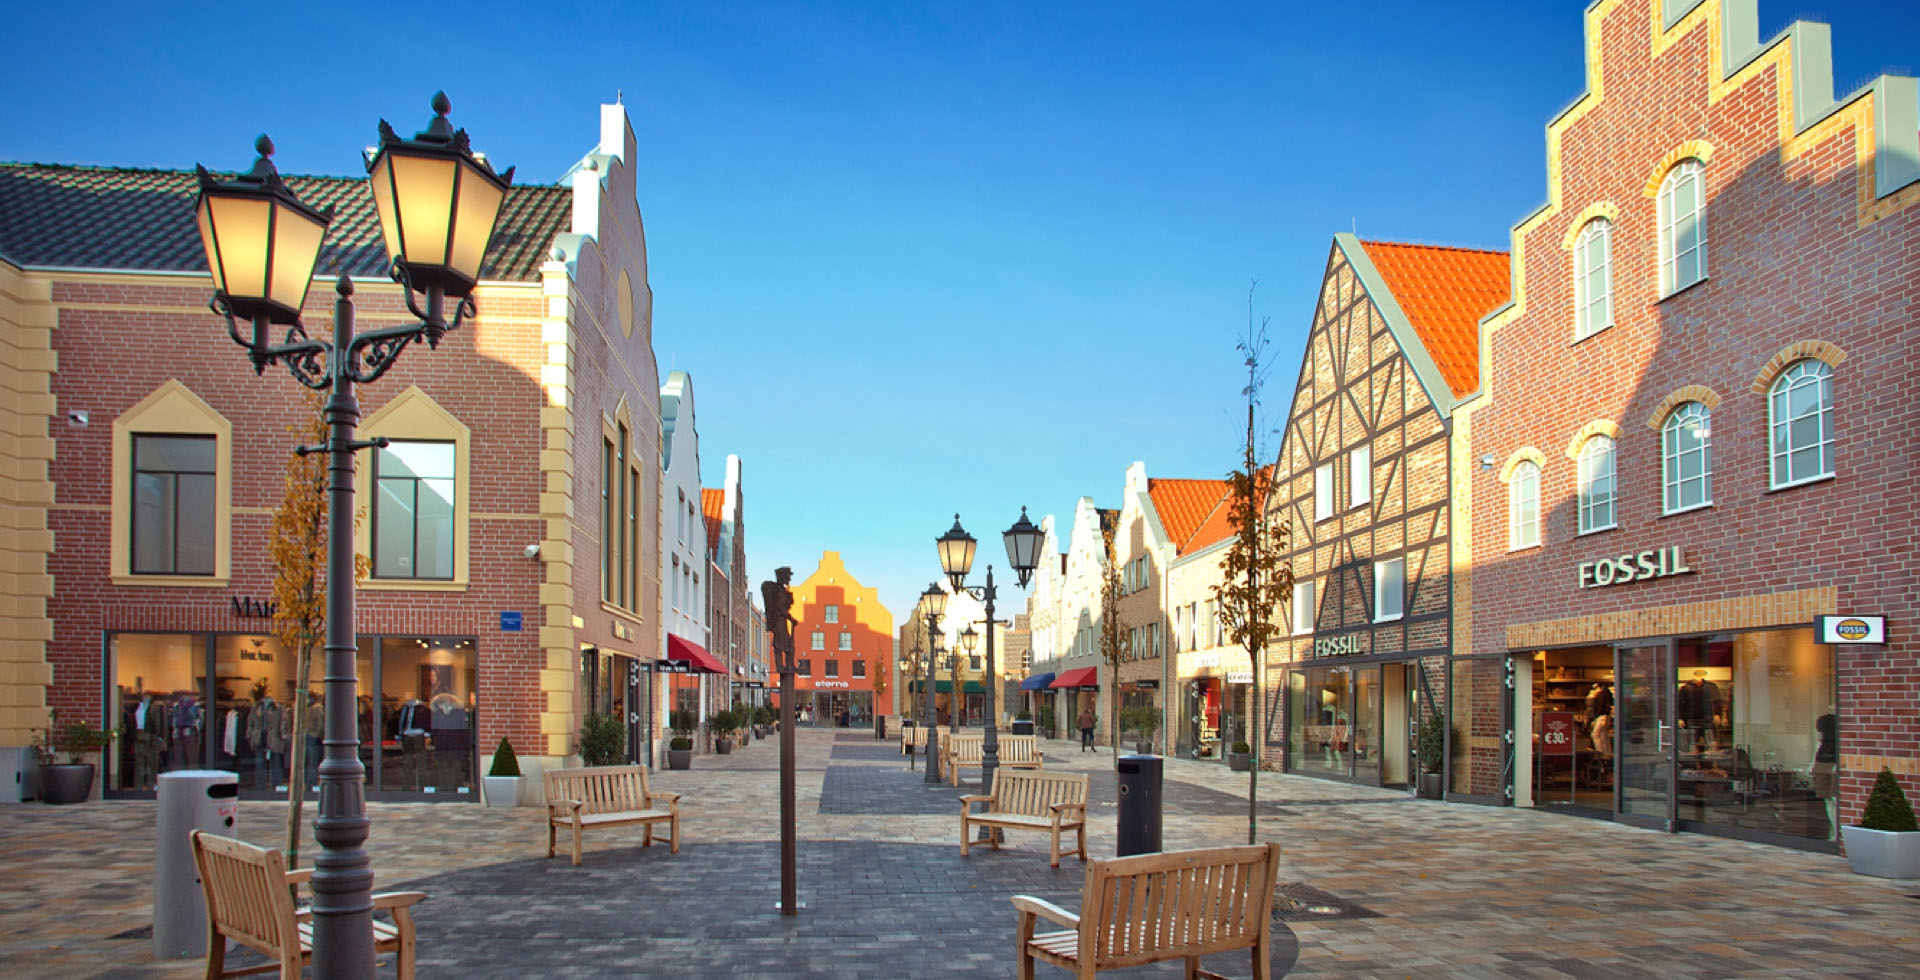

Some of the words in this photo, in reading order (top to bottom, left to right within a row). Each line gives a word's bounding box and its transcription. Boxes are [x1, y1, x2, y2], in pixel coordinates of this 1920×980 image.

[1579, 546, 1689, 588] FOSSIL
[1839, 625, 1867, 634] FOSSIL
[1316, 635, 1360, 658] FOSSIL
